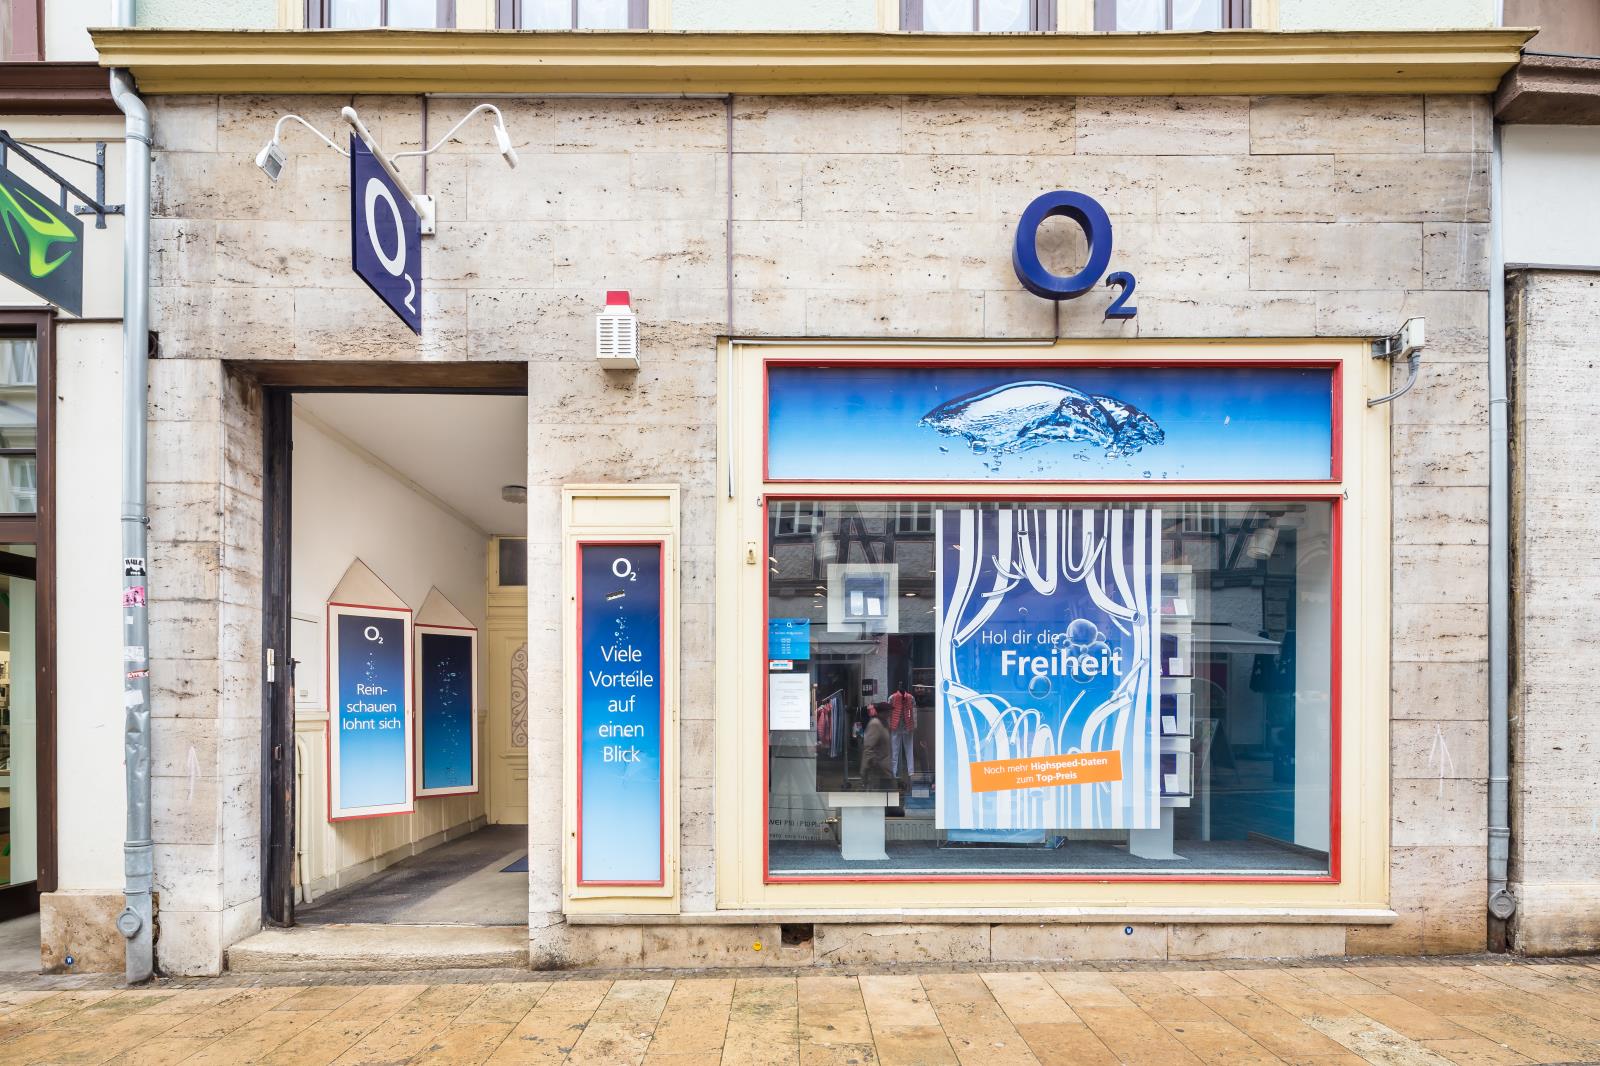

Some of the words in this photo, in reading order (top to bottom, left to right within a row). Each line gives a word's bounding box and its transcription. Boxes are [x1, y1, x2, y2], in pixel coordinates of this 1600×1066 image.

[364, 176, 417, 315] O2
[1012, 190, 1137, 318] O2
[613, 557, 637, 582] O2
[363, 625, 384, 645] O2
[982, 629, 1007, 645] Hol
[1012, 629, 1031, 645] dir
[1038, 629, 1060, 645] die
[600, 645, 642, 662] Viele
[1001, 649, 1124, 677] Freiheit
[589, 670, 654, 688] Vorteile
[357, 683, 388, 696] Rein-
[346, 699, 398, 713] schauen
[608, 695, 636, 713] auf
[342, 715, 376, 731] lohnt
[378, 715, 401, 730] sich
[599, 720, 644, 738] einen
[603, 745, 641, 763] Blick
[983, 764, 1005, 775] Noch
[1007, 762, 1028, 773] mehr
[1030, 757, 1108, 771] Highspeed-Daten
[1016, 776, 1034, 784] zum
[1036, 770, 1078, 783] Top-Preis
